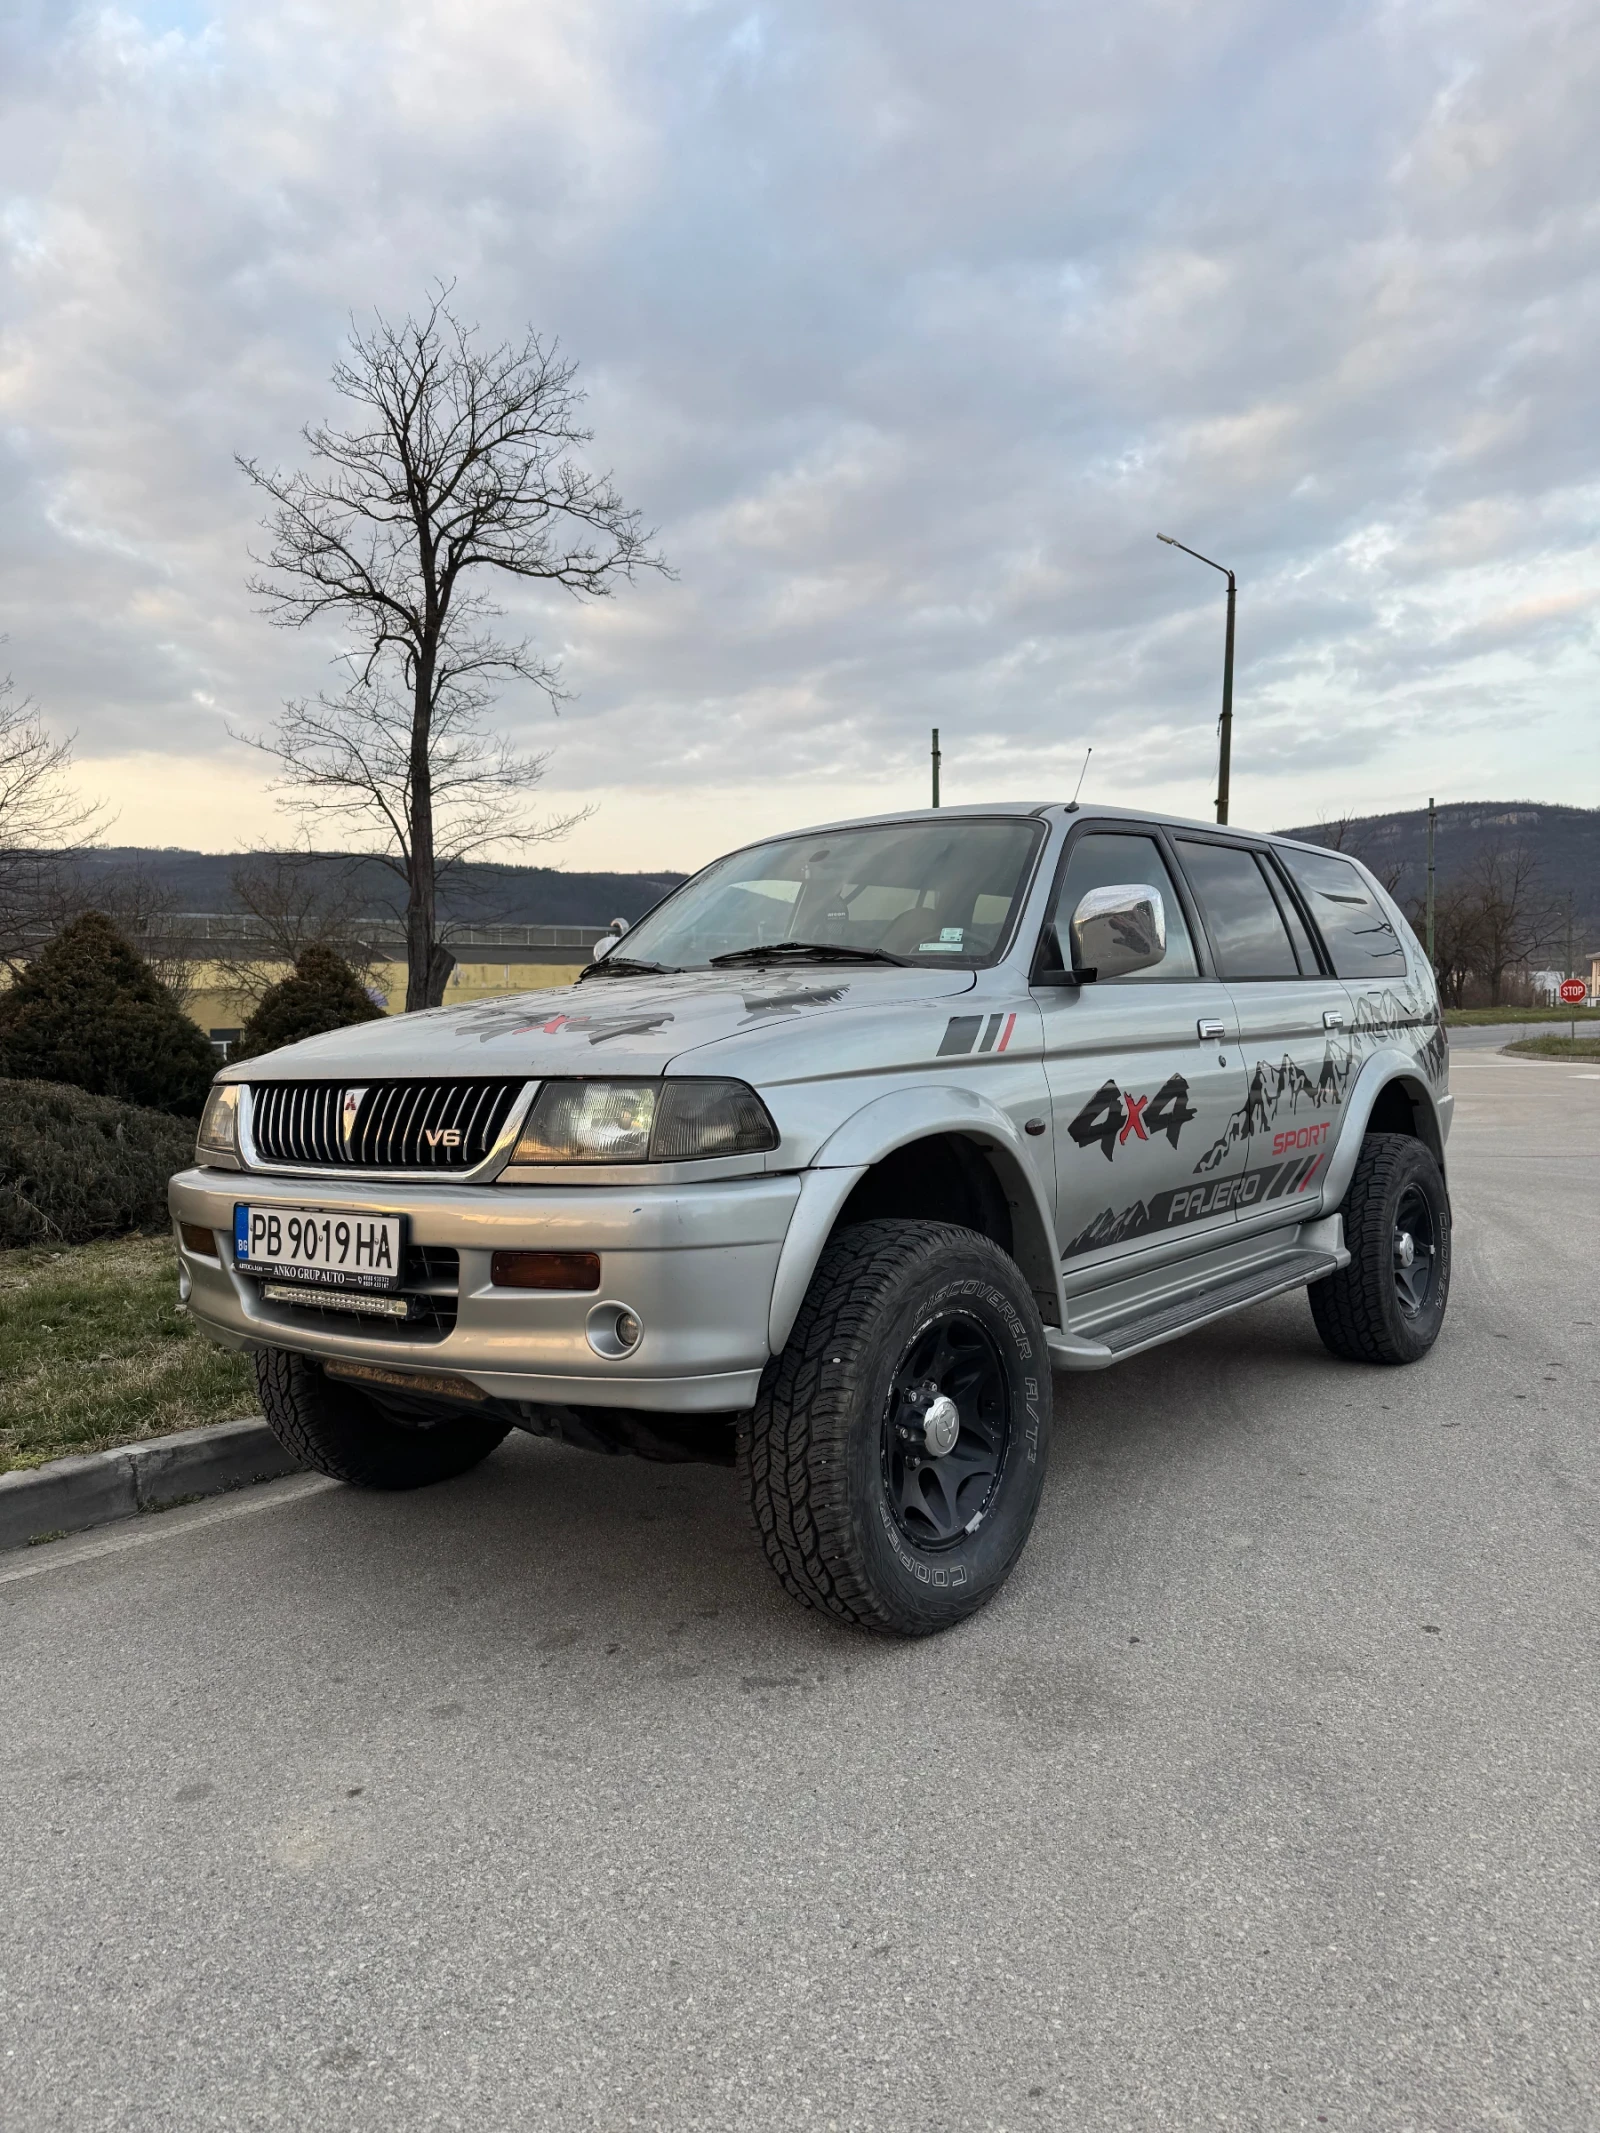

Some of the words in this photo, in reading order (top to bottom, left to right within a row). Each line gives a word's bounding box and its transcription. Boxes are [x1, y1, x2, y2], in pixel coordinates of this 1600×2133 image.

[1562, 985, 1584, 996] STOP
[425, 1129, 461, 1147] V6
[1272, 1122, 1331, 1156] SPORT
[1167, 1174, 1261, 1222] PAJERO
[238, 1239, 248, 1251] BG
[252, 1213, 282, 1256] PB
[287, 1217, 350, 1264] 9019
[356, 1222, 392, 1268] HA
[1434, 1212, 1449, 1310] COOPER
[273, 1264, 297, 1278] ANKO
[297, 1267, 320, 1281] GRUP
[320, 1271, 345, 1284] AUTO
[913, 1279, 1032, 1361] DISCOVERER
[879, 1501, 968, 1588] COOPER
